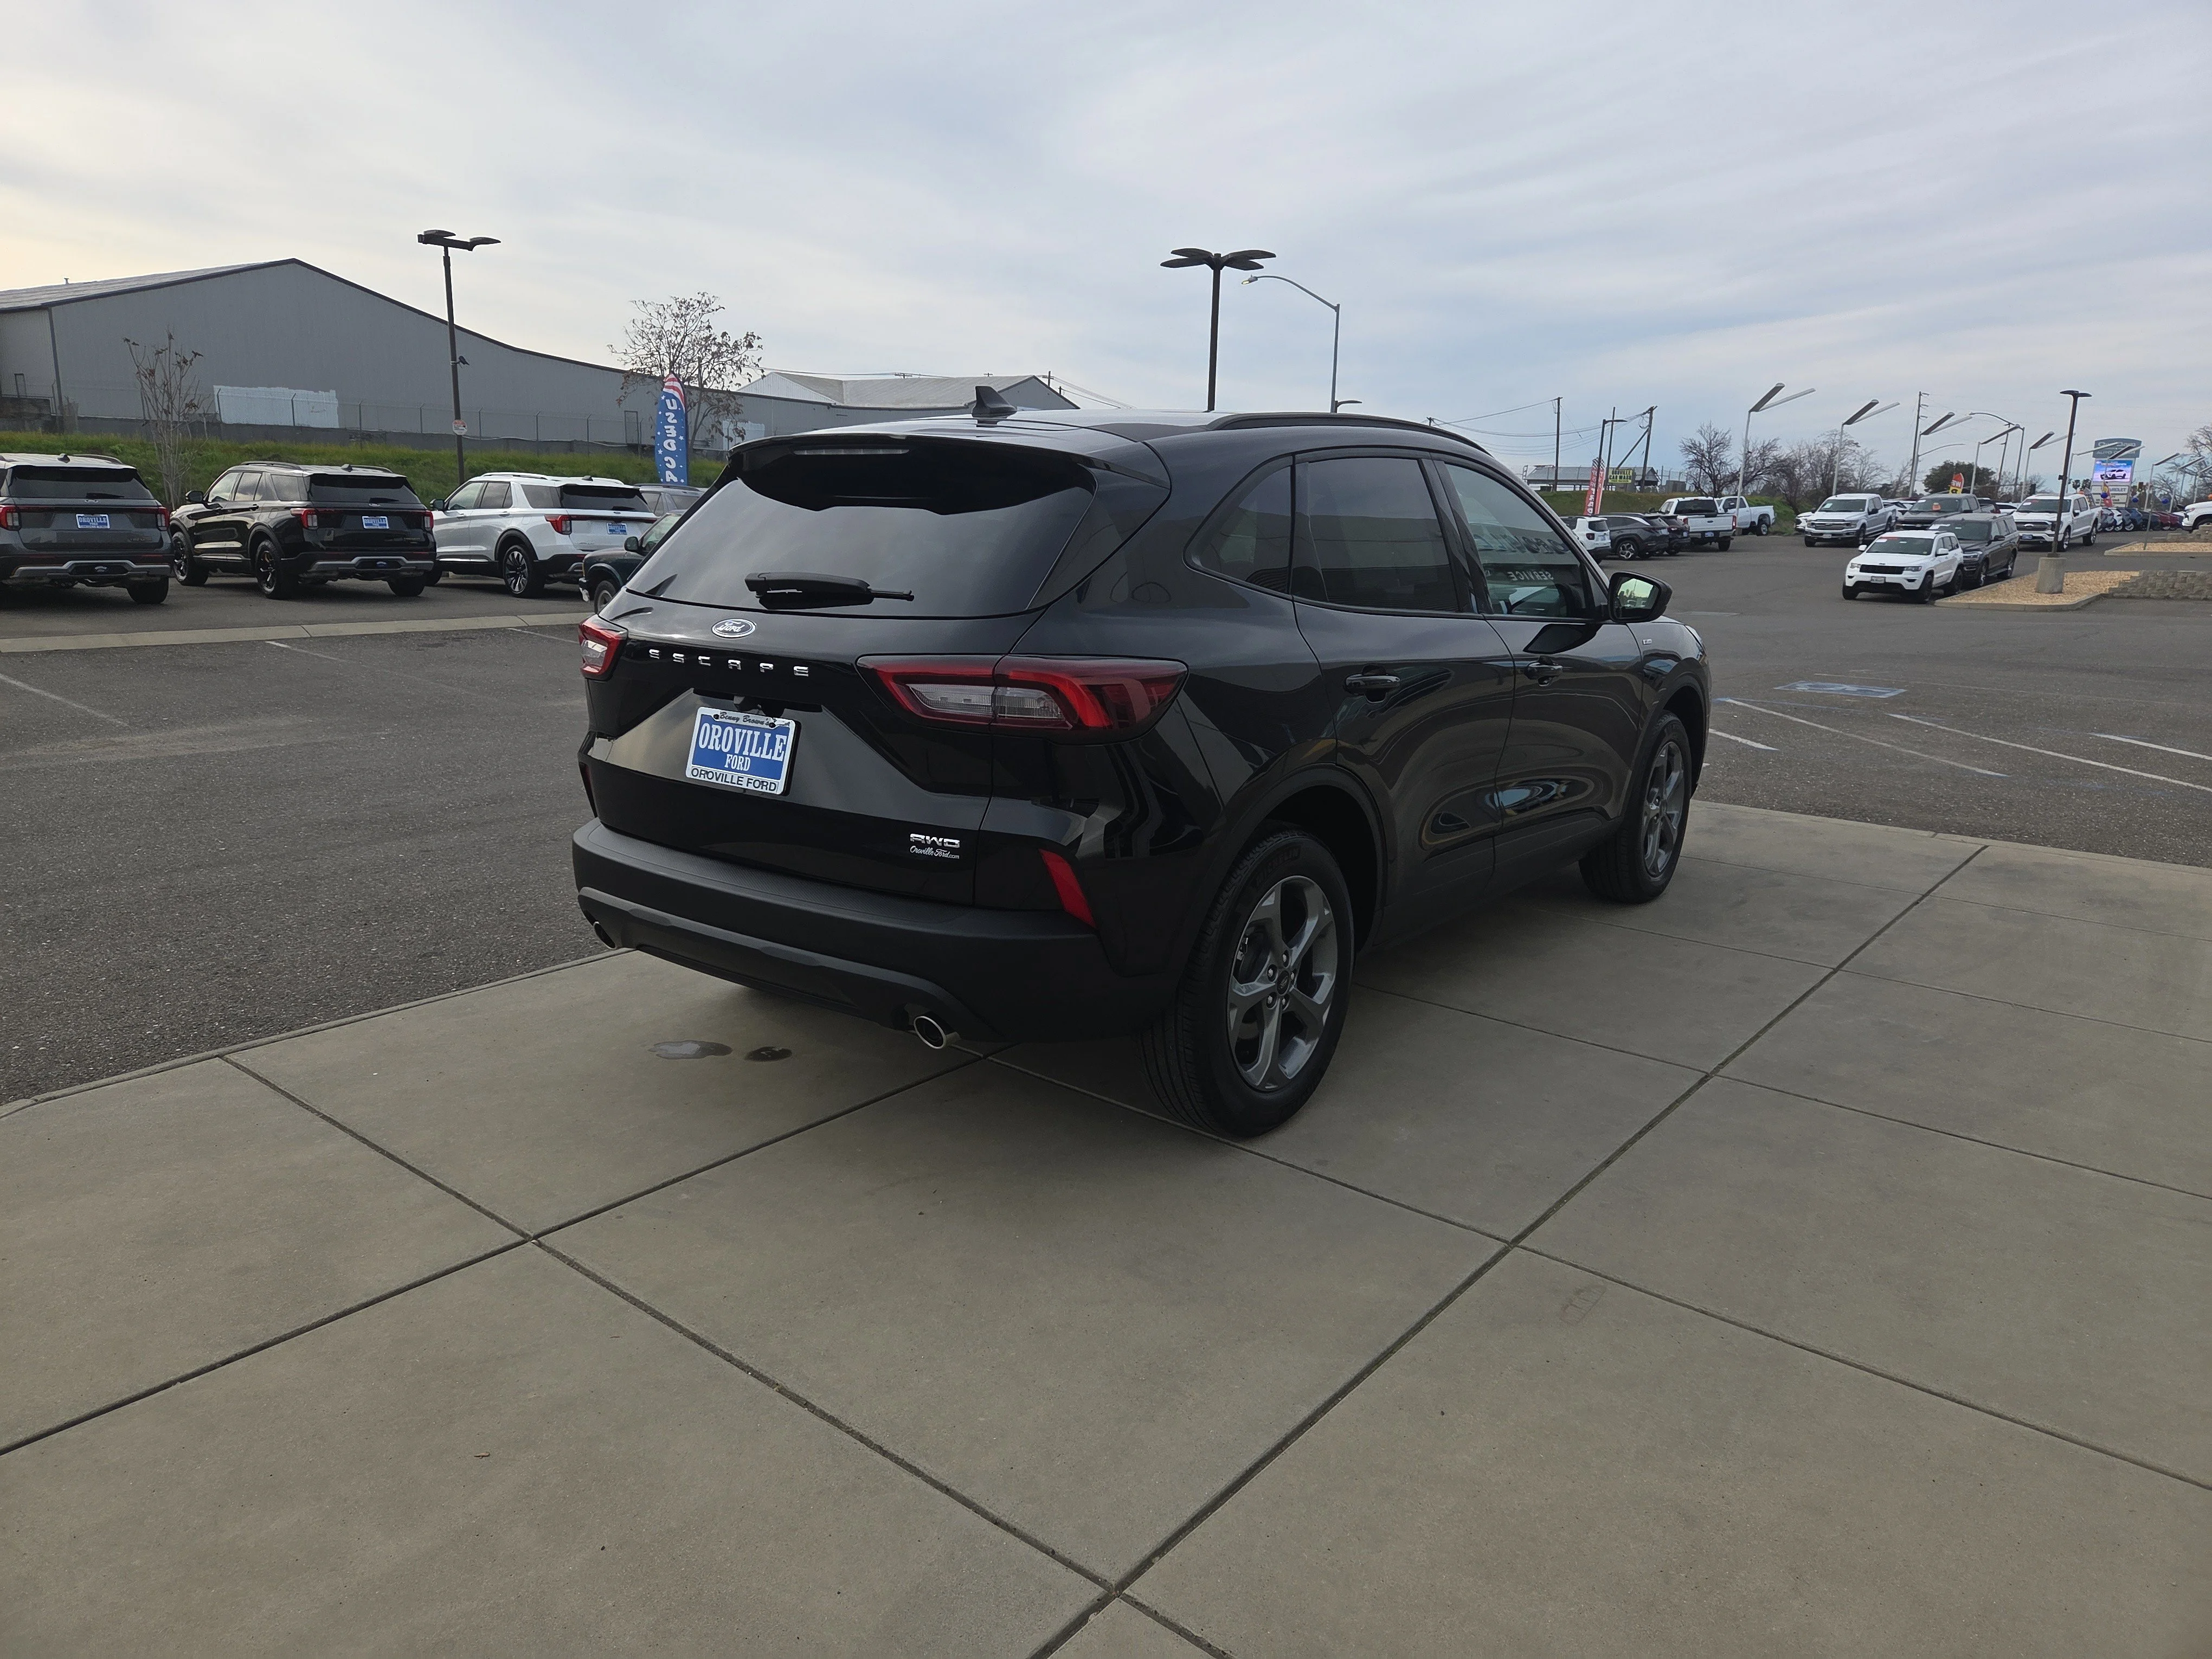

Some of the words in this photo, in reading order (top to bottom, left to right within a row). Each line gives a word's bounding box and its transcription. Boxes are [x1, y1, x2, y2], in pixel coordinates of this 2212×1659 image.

[649, 649, 809, 677] ESCAPE
[719, 711, 740, 723] Benny
[698, 723, 787, 762] OROVILLE
[724, 754, 751, 772] FORD
[691, 768, 744, 786] OROVILLE
[746, 778, 777, 792] FORD
[910, 833, 960, 848] AWD
